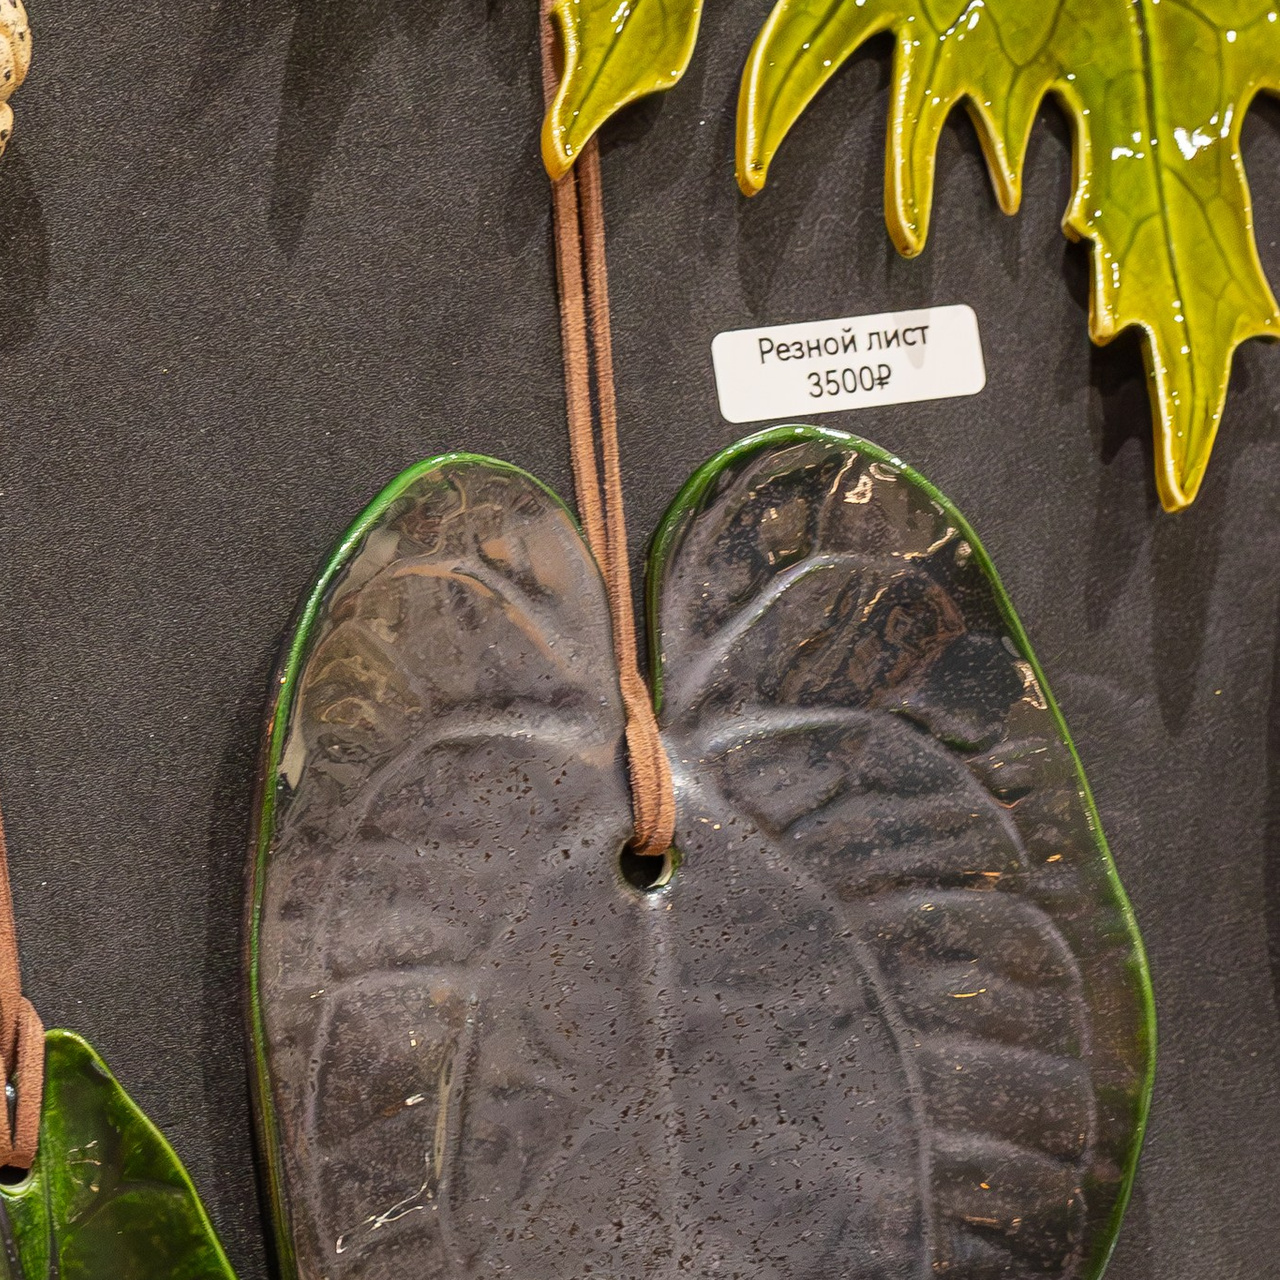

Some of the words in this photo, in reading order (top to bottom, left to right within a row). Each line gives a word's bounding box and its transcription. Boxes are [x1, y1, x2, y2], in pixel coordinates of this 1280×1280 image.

[758, 327, 857, 364] Резной
[867, 325, 930, 351] лист
[807, 363, 892, 398] 3500₽
